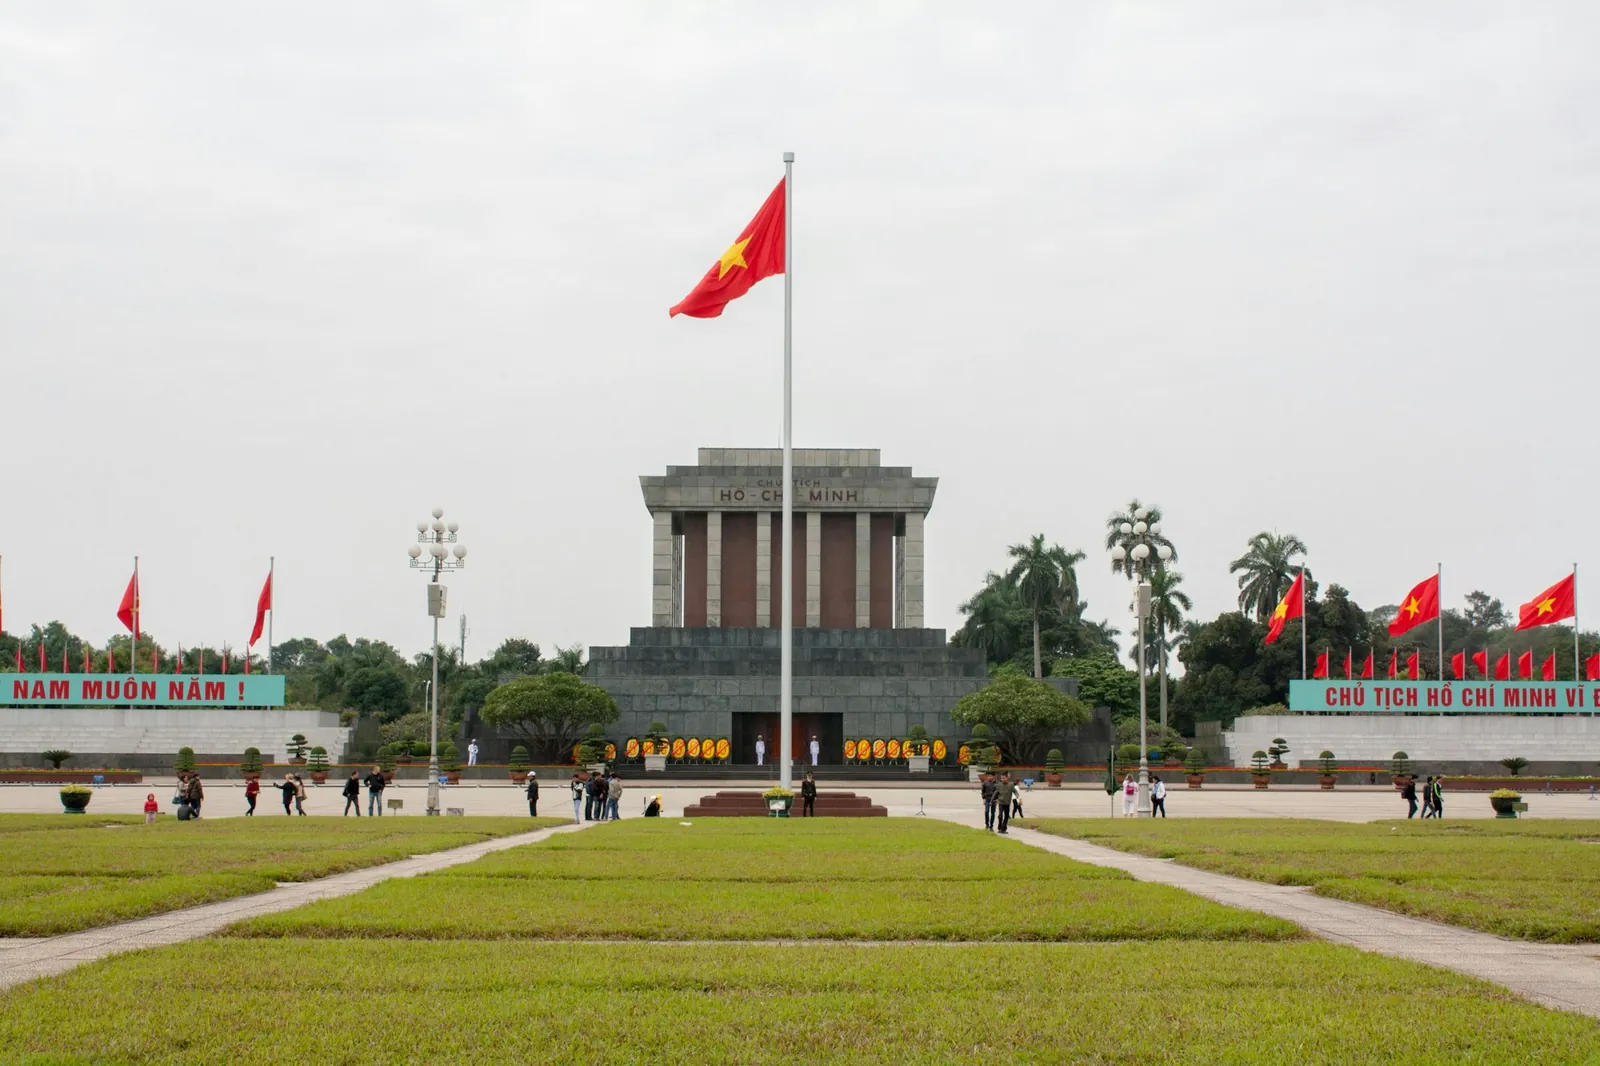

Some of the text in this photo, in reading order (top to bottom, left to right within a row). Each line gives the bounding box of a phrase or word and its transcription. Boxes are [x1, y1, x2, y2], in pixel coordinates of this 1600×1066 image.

[13, 679, 70, 700] NAM
[82, 677, 157, 700] MUÔN
[168, 677, 225, 701] NĂM
[1325, 681, 1365, 707] CHỦ
[1374, 687, 1418, 710] TỊCH
[1427, 681, 1452, 707] HỒ
[1462, 684, 1495, 707] CHÍ
[1504, 688, 1556, 707] MINH
[1565, 684, 1584, 707] VĨ
